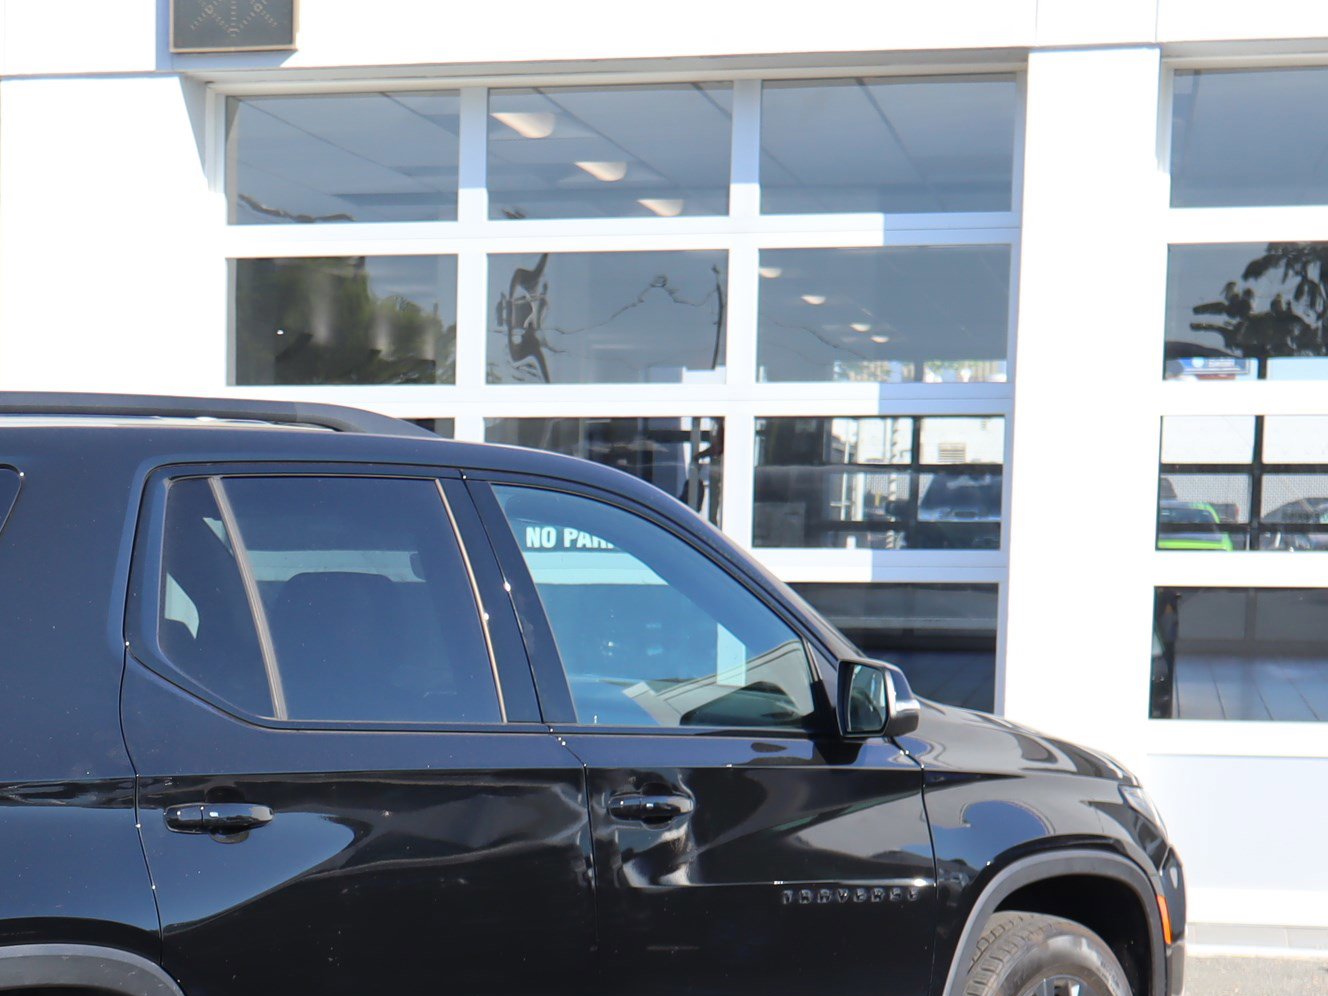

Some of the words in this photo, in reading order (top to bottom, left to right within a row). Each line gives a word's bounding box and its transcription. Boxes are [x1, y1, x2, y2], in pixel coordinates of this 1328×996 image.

[525, 526, 557, 549] NO
[563, 527, 615, 549] PAR
[782, 886, 920, 905] TRAVERSE
